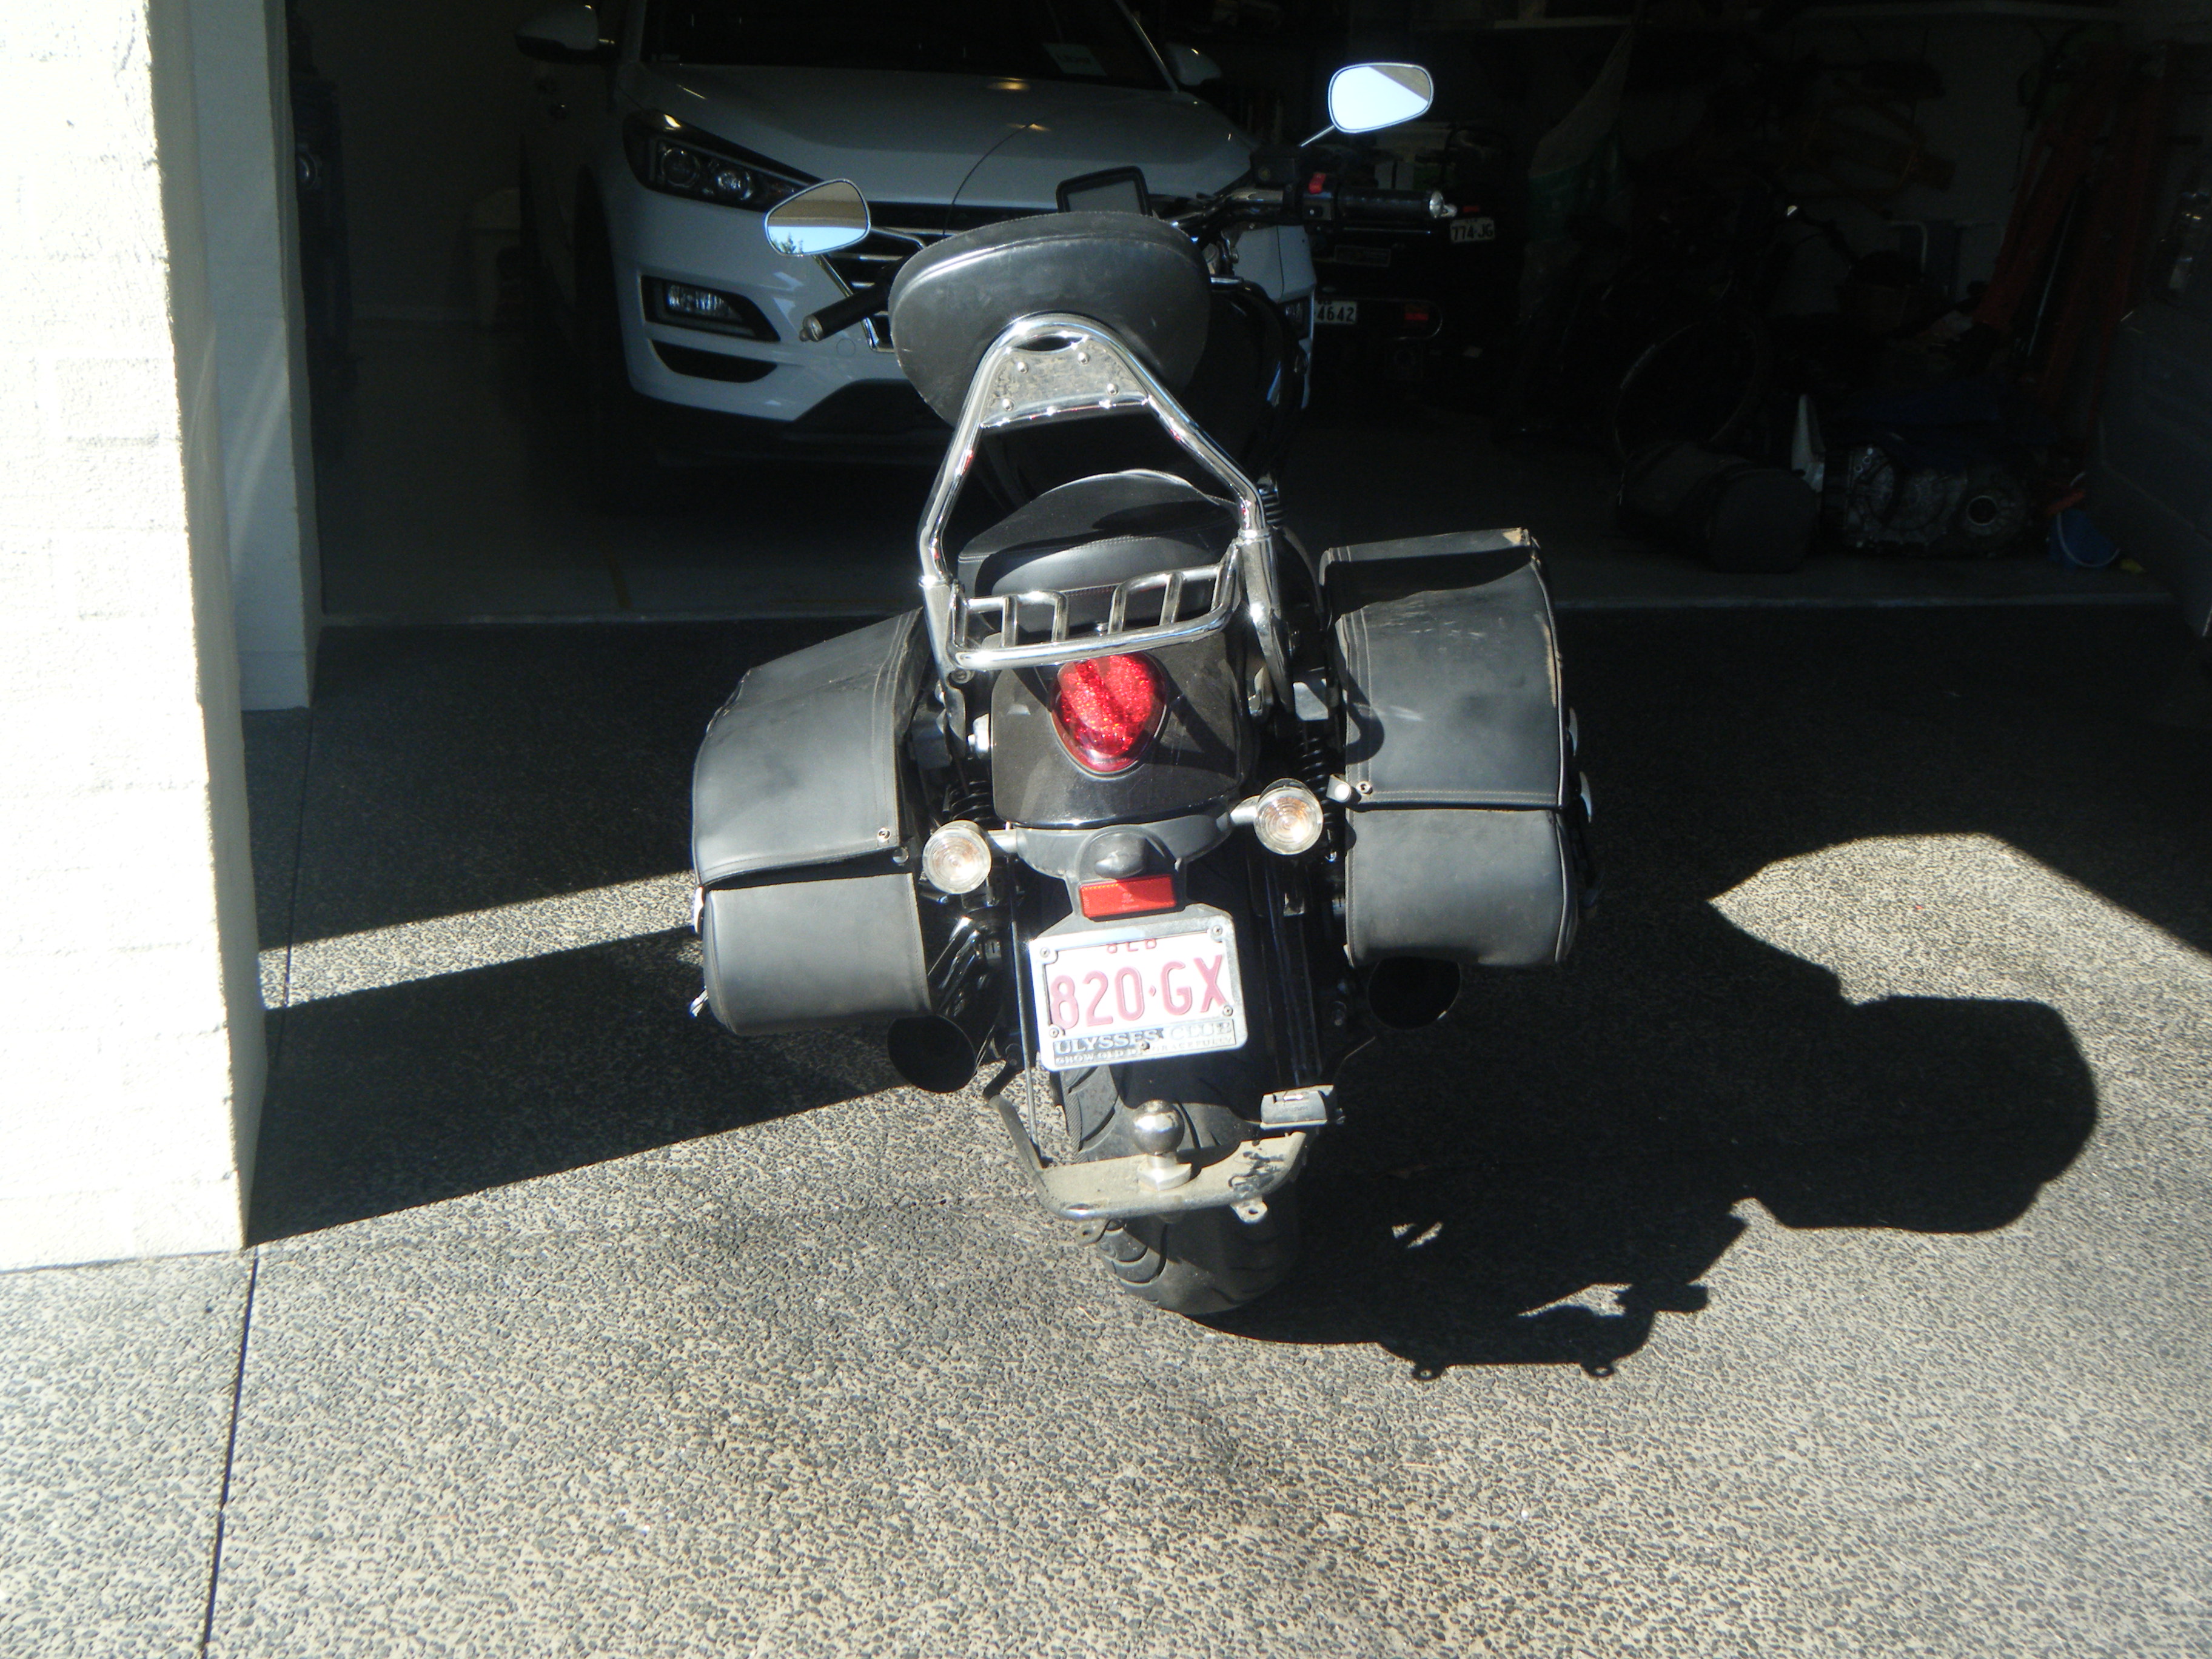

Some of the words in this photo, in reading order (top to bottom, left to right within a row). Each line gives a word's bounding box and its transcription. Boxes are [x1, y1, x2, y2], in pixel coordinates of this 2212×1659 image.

[1054, 1028, 1160, 1054] ULYSSES
[1170, 1021, 1232, 1041] CLUB
[1127, 1037, 1232, 1056] DIGRACEFULLY
